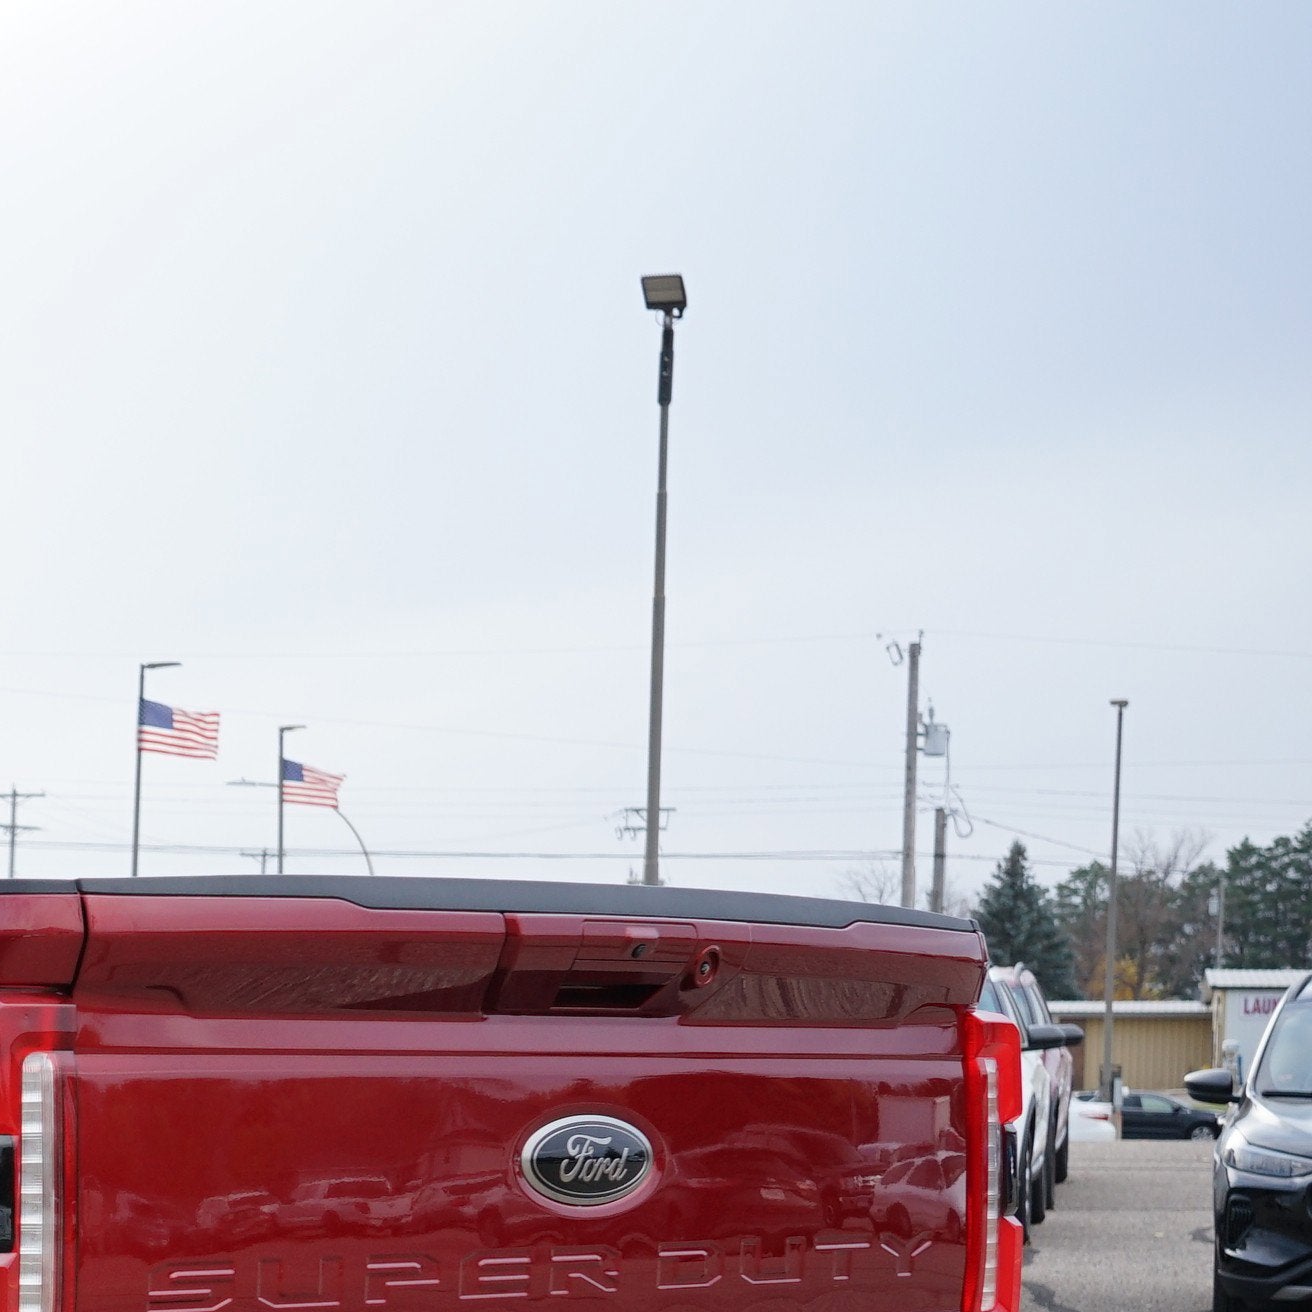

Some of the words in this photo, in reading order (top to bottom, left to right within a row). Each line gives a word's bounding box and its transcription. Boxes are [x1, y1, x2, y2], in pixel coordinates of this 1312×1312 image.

[1243, 997, 1281, 1015] LAUN
[559, 1134, 629, 1183] Ford
[657, 1230, 934, 1290] DUTY
